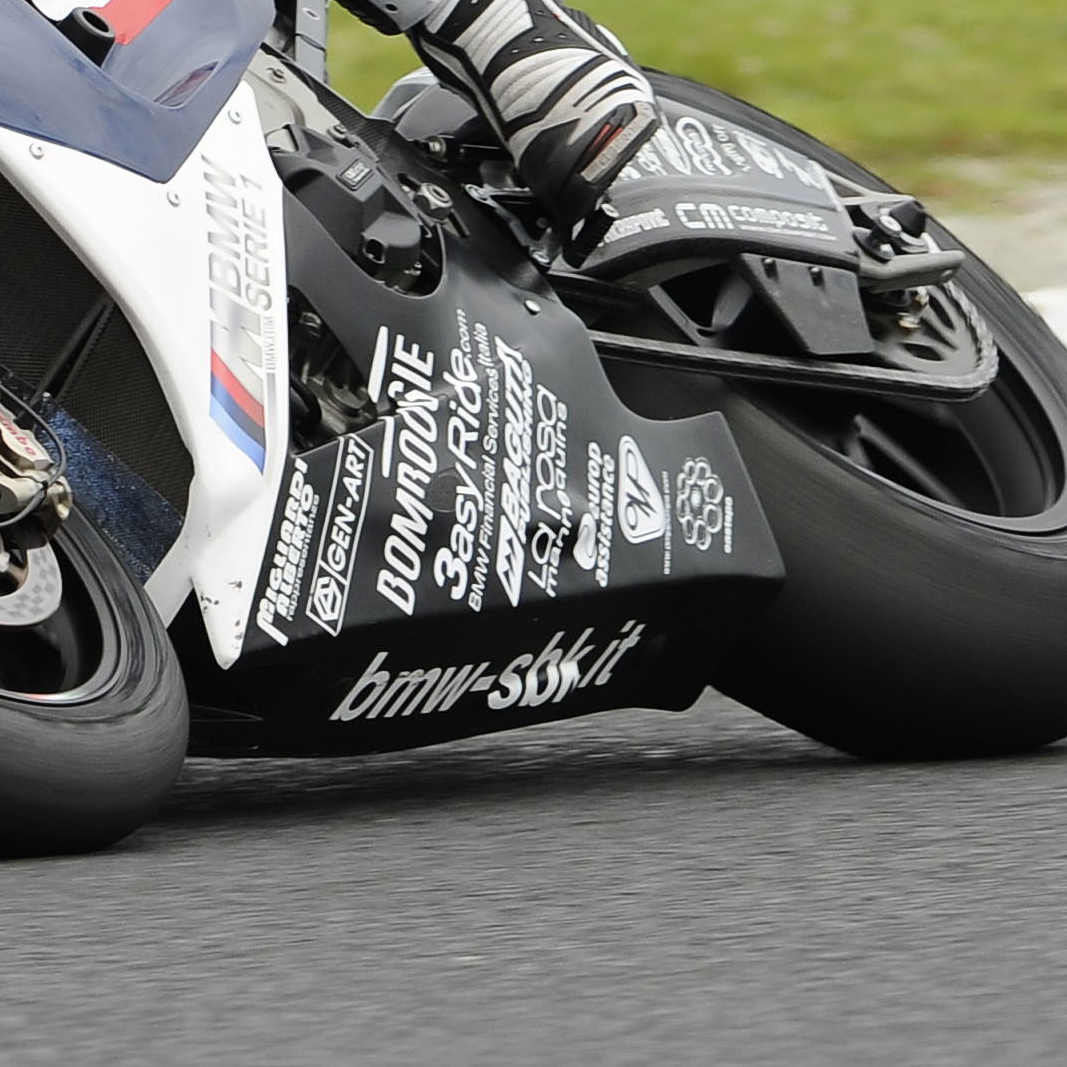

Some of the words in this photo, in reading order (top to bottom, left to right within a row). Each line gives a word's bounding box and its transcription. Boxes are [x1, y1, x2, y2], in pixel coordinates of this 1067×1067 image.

[201, 153, 242, 298] BMW
[239, 173, 263, 190] 1
[675, 202, 734, 229] CM
[242, 198, 273, 312] SERIE
[473, 322, 495, 367] Italia
[483, 368, 500, 454] Services
[536, 383, 562, 520] rosa
[327, 438, 367, 572] GEN-ART
[479, 454, 496, 550] Financial
[546, 401, 573, 598] mannequins
[587, 442, 603, 520] europ
[595, 454, 615, 587] assistance
[276, 484, 314, 620] ALBERTO
[468, 547, 490, 612] BMW
[329, 620, 646, 722] bmw-sbkit
